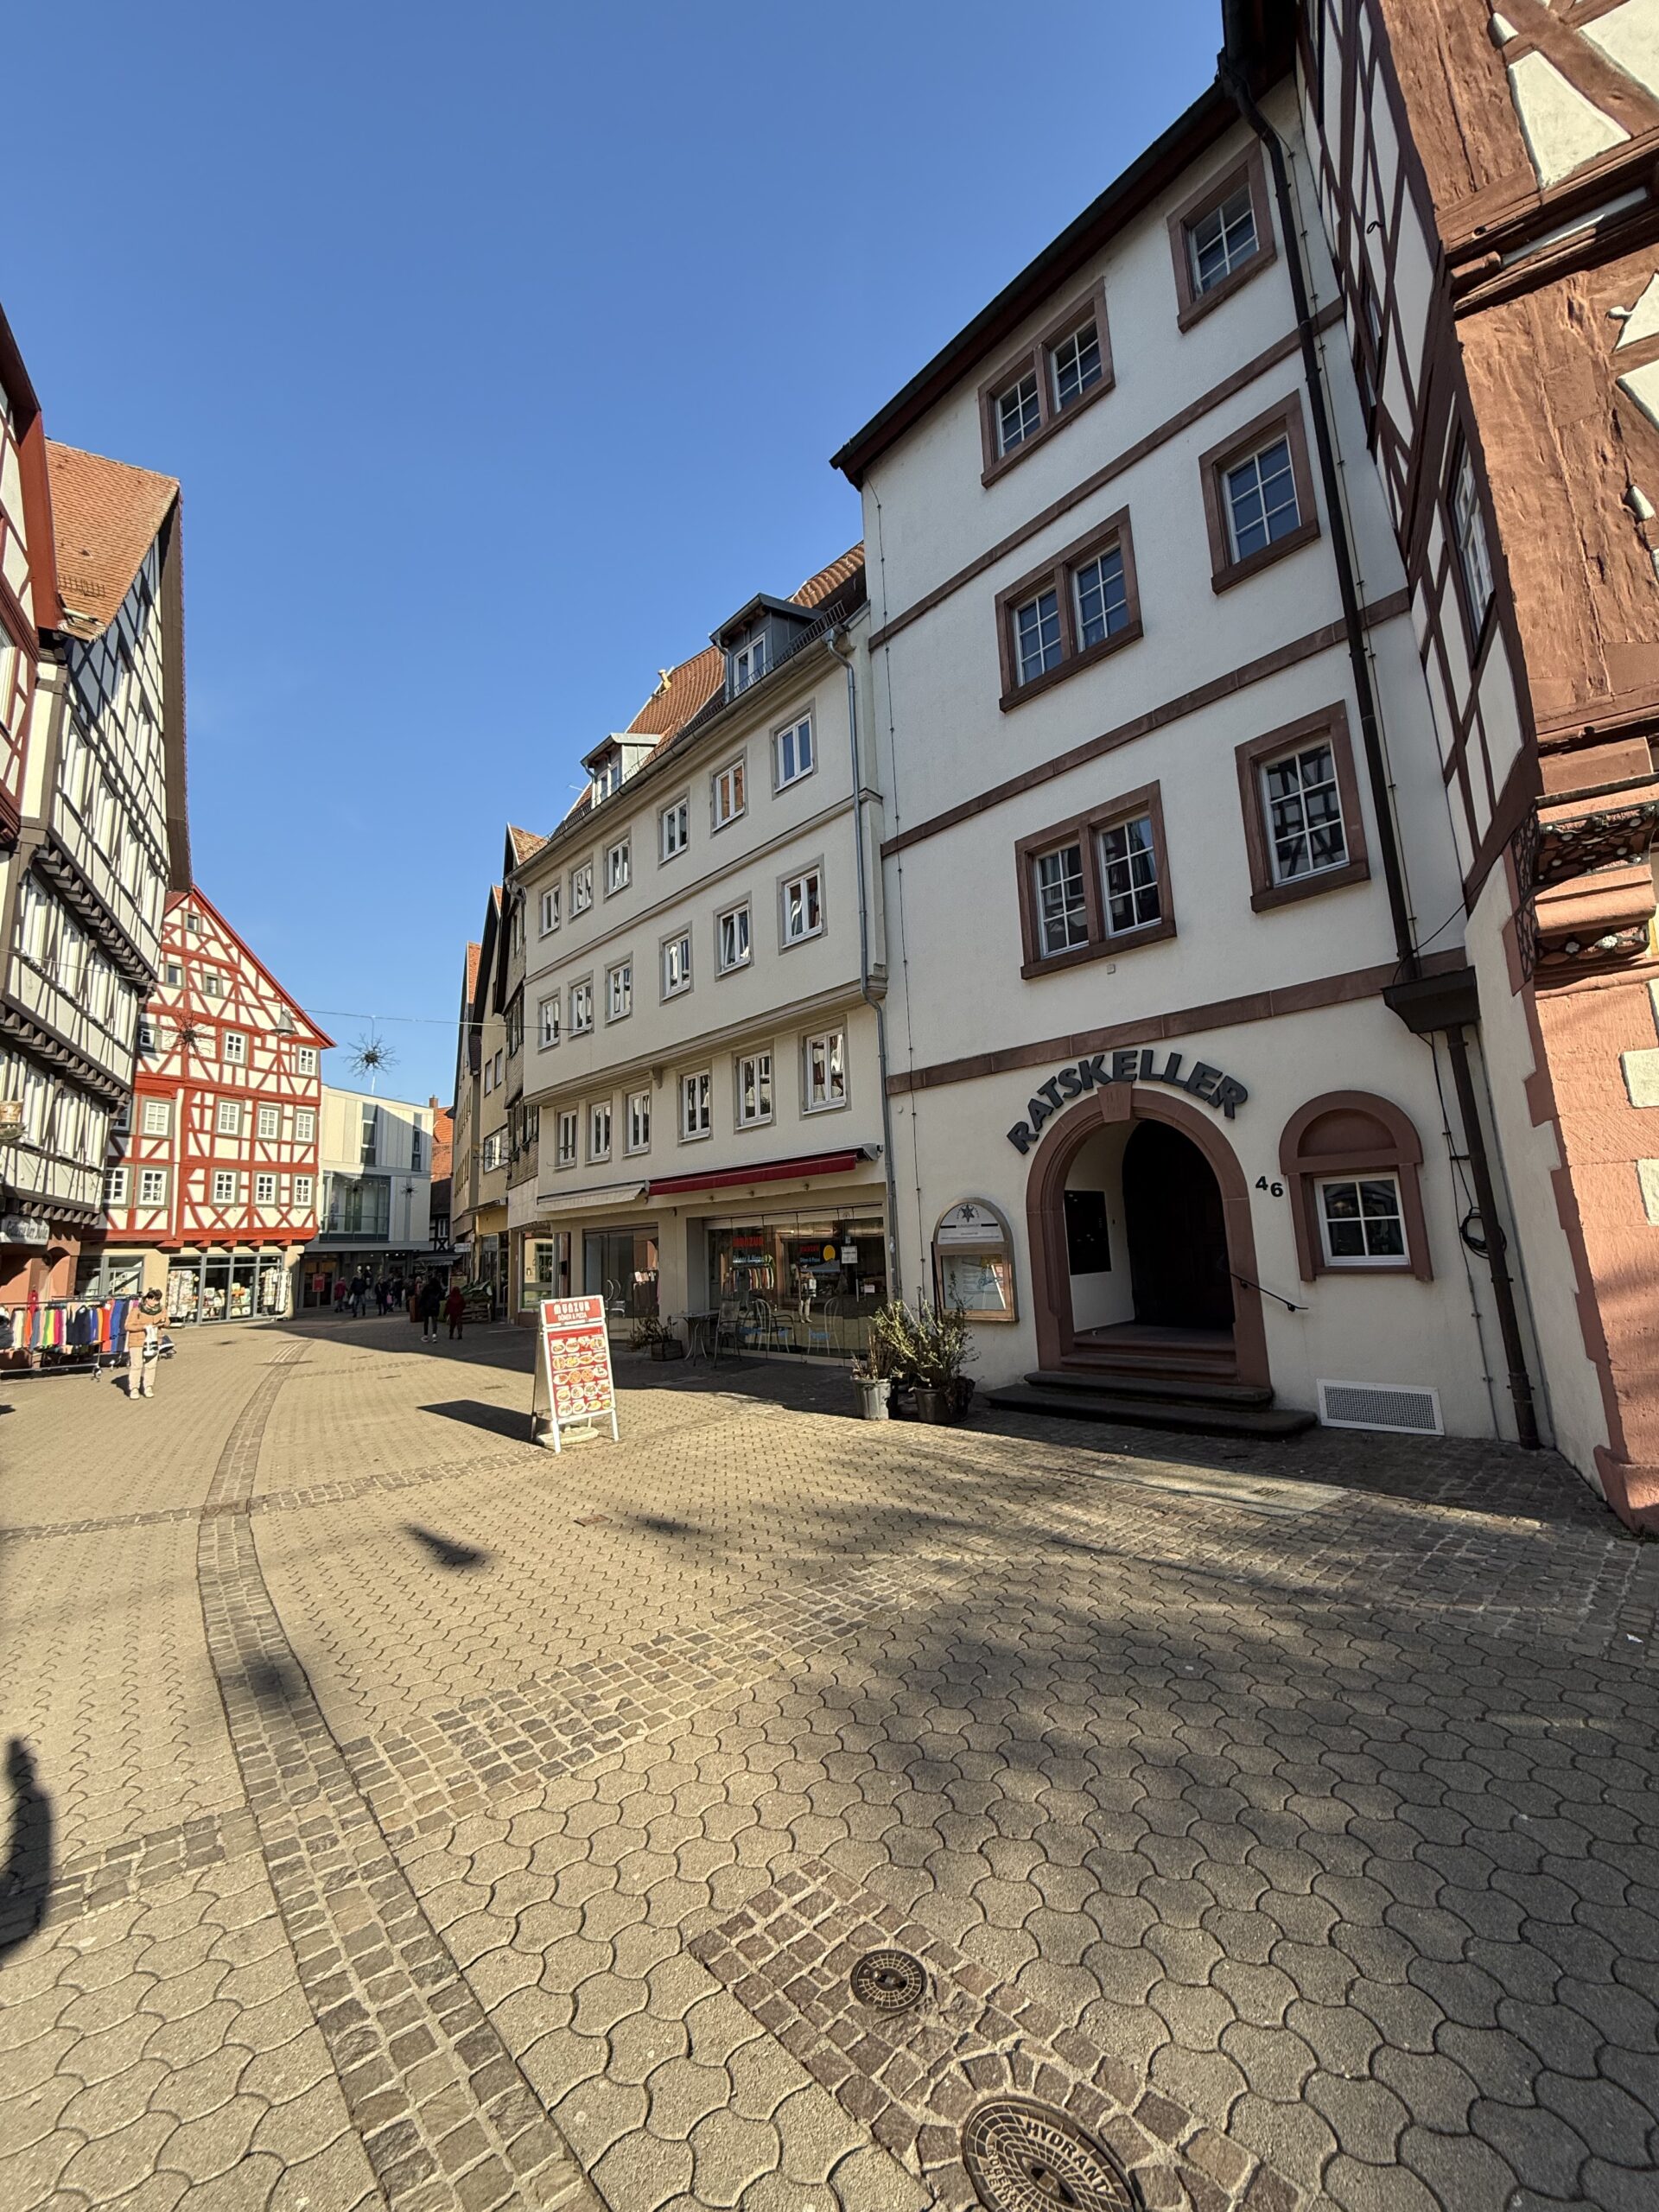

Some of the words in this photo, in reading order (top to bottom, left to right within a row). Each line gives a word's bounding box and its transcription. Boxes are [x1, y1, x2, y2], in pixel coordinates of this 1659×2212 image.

[1007, 1049, 1249, 1154] RATSKELLER
[1255, 1176, 1284, 1198] 46
[1026, 2120, 1110, 2193] HYDRANT
